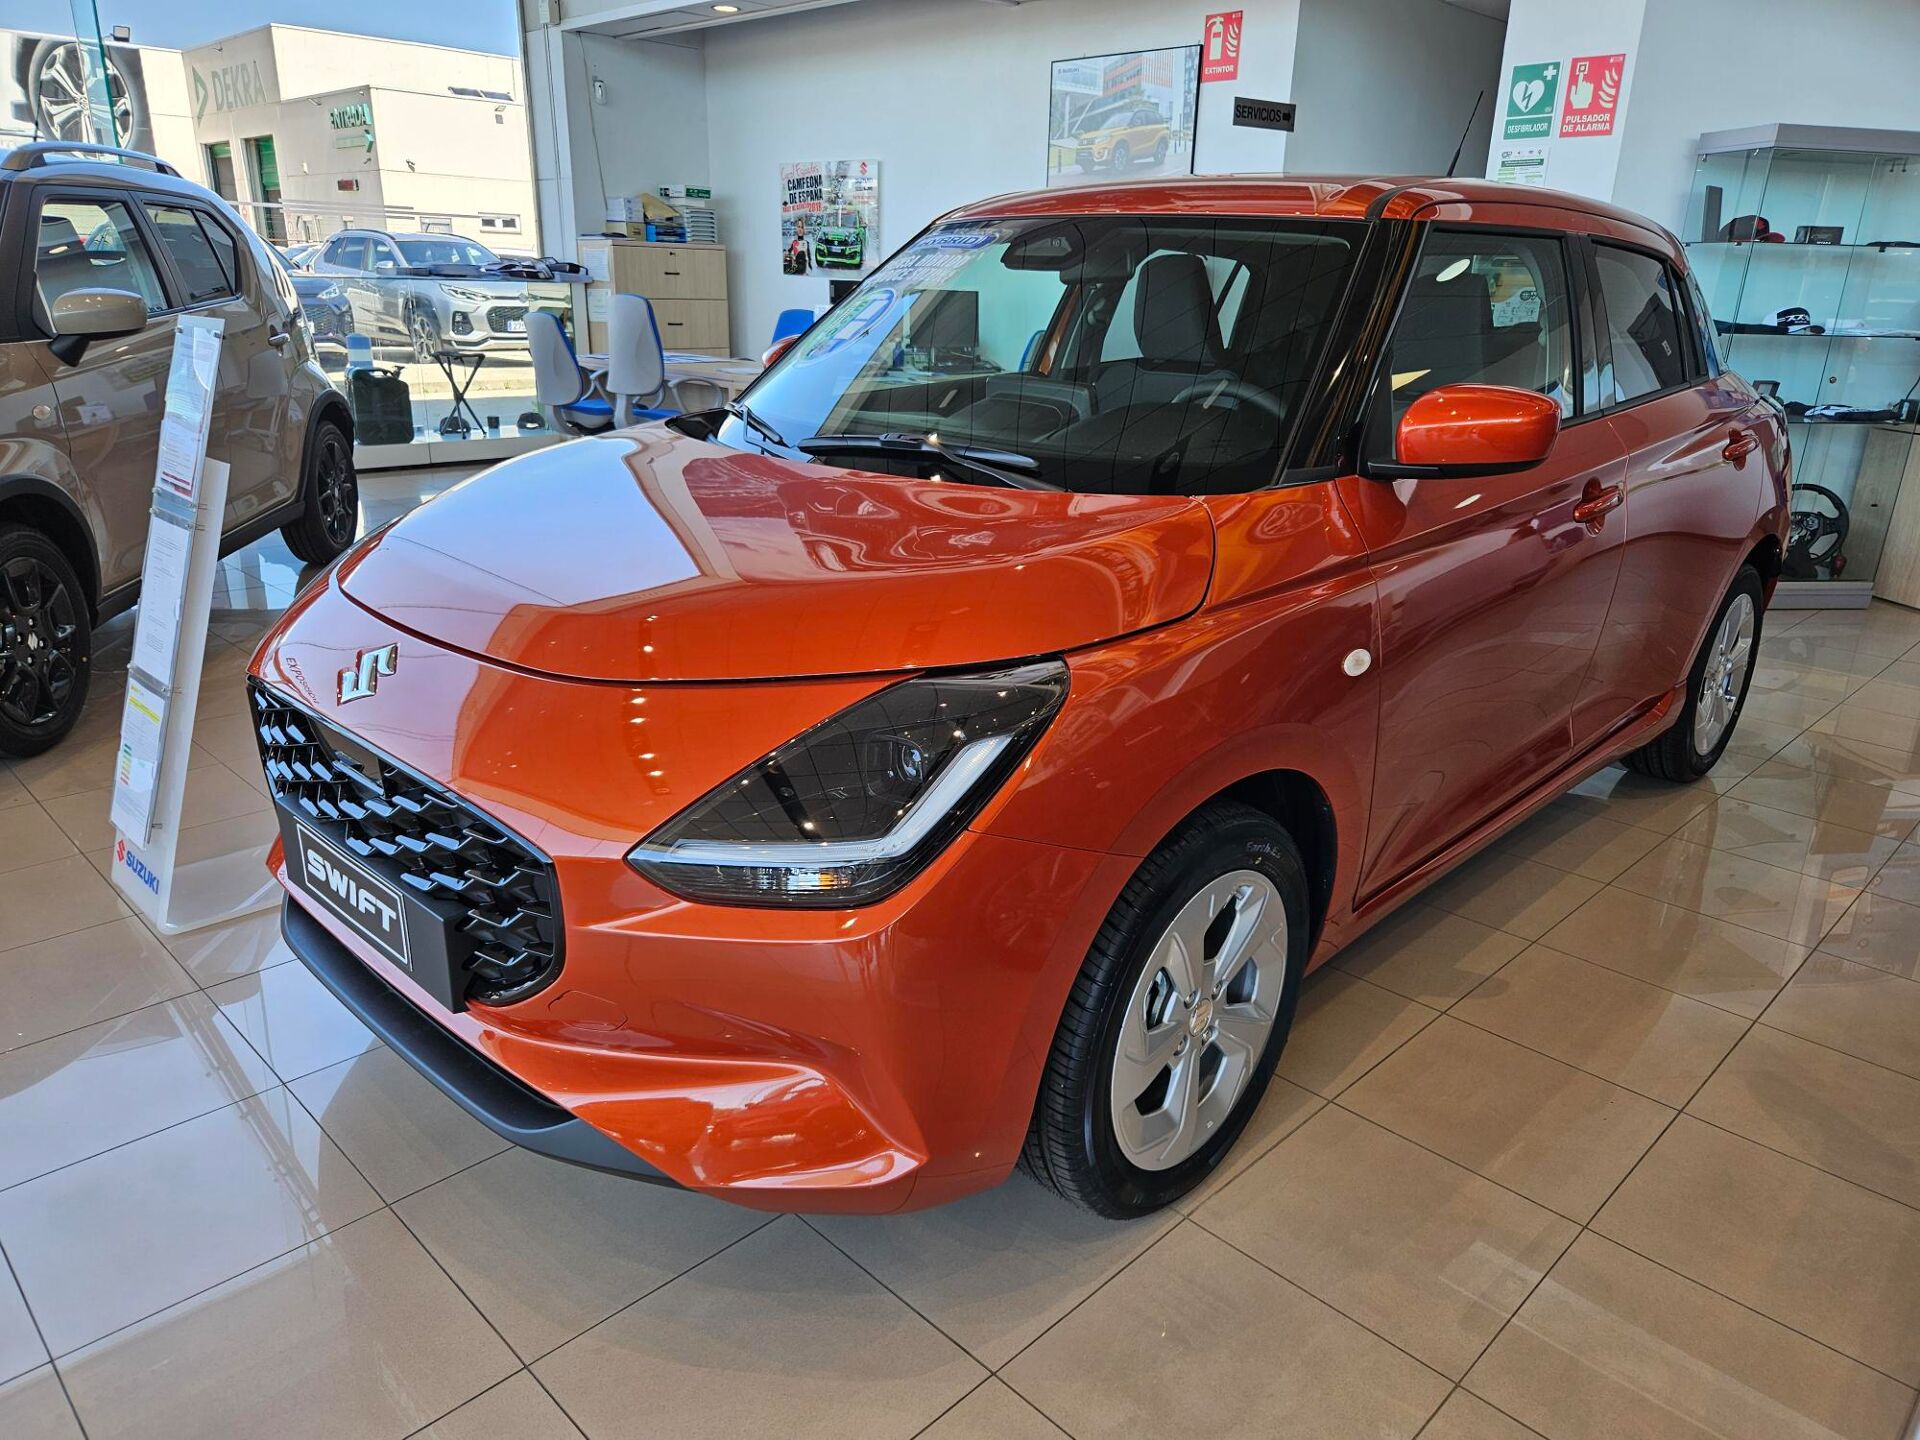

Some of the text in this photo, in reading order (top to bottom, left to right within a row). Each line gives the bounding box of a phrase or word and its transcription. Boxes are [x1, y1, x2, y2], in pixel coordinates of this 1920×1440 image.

[1205, 65, 1234, 74] EXTINTOR
[211, 61, 267, 111] DEKRA
[330, 104, 372, 130] ENTRADA
[1235, 105, 1282, 122] SERVICIOS
[1566, 113, 1610, 123] PULSADOR
[1507, 123, 1549, 133] DESFIBRILADOR
[1562, 123, 1610, 133] DE ALARMA
[788, 175, 823, 191] CAMPEONA
[789, 192, 798, 204] DE
[126, 850, 160, 895] SUZUKI
[307, 849, 397, 932] SWIFT
